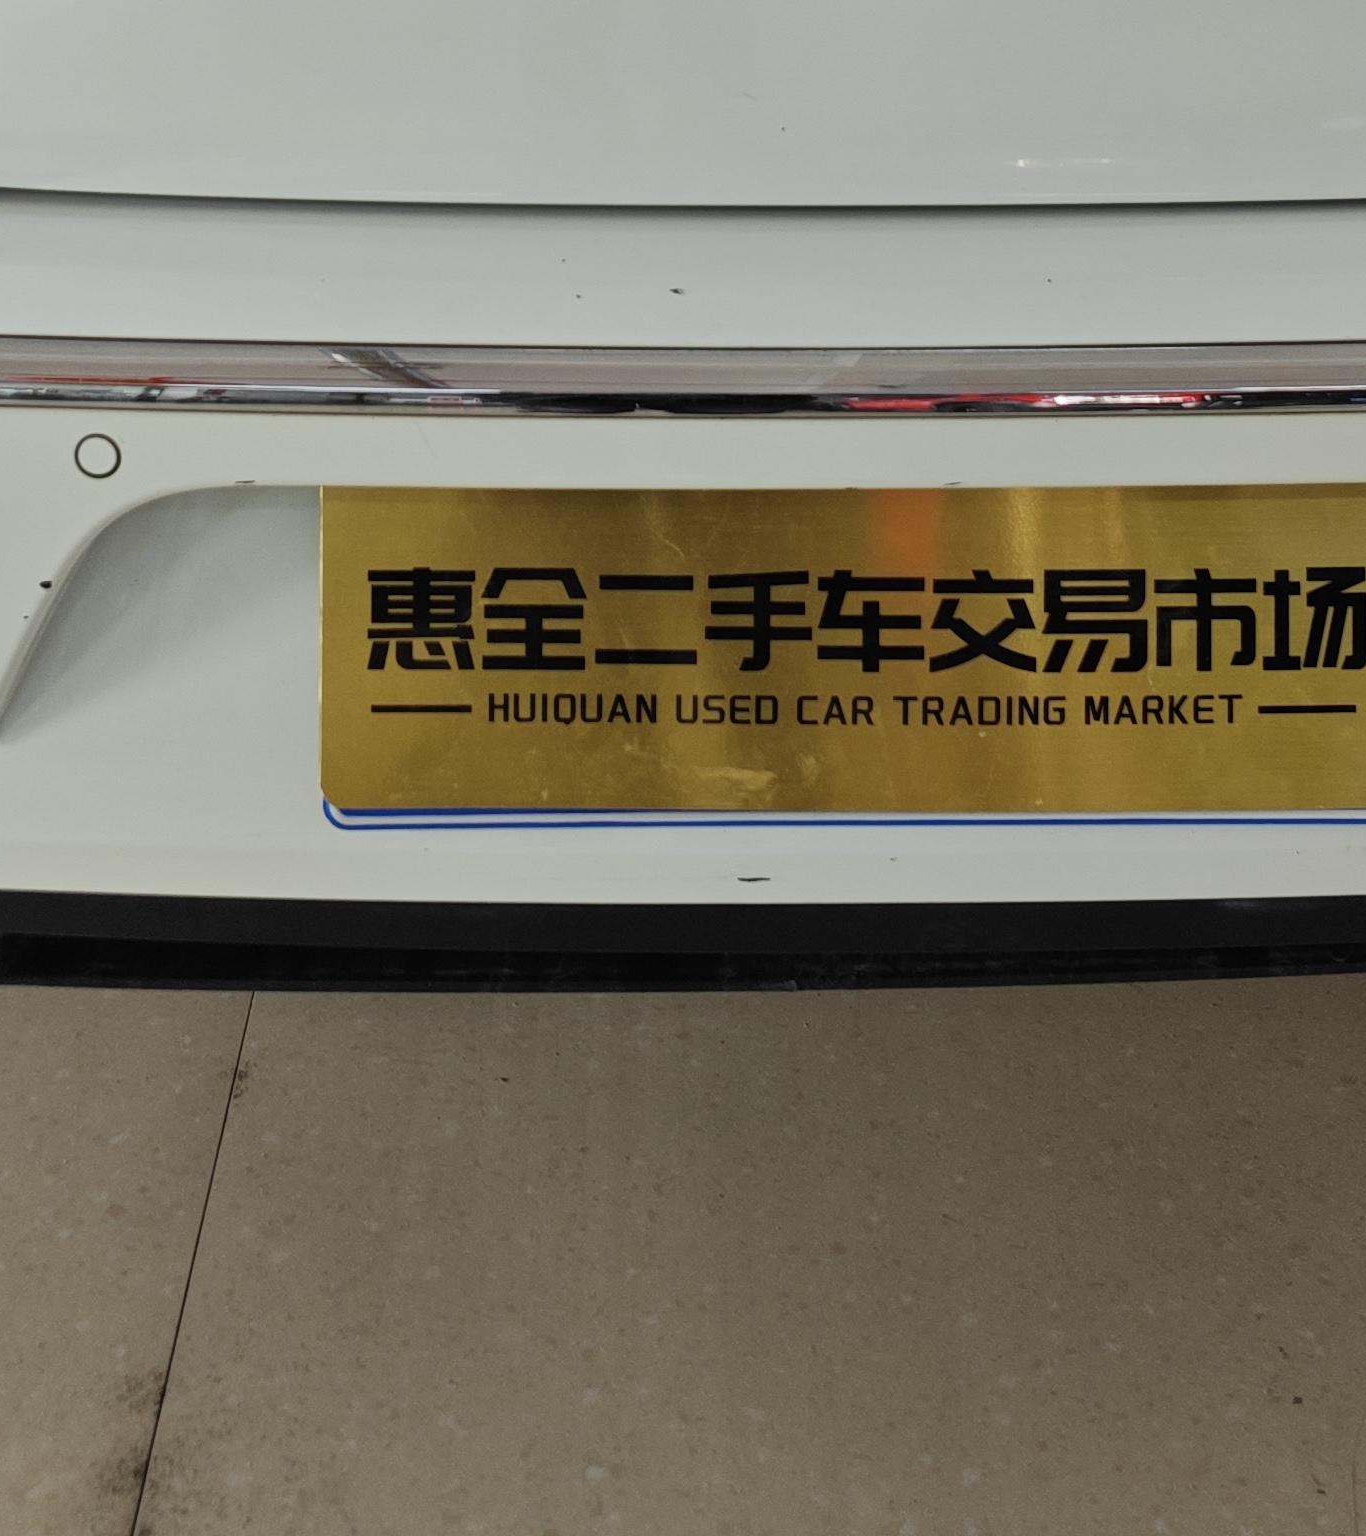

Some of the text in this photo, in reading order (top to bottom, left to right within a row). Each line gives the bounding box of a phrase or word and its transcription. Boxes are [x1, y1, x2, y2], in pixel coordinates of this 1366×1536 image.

[487, 693, 1243, 727] HUIQUAN USED CAR TRADING MARKET
